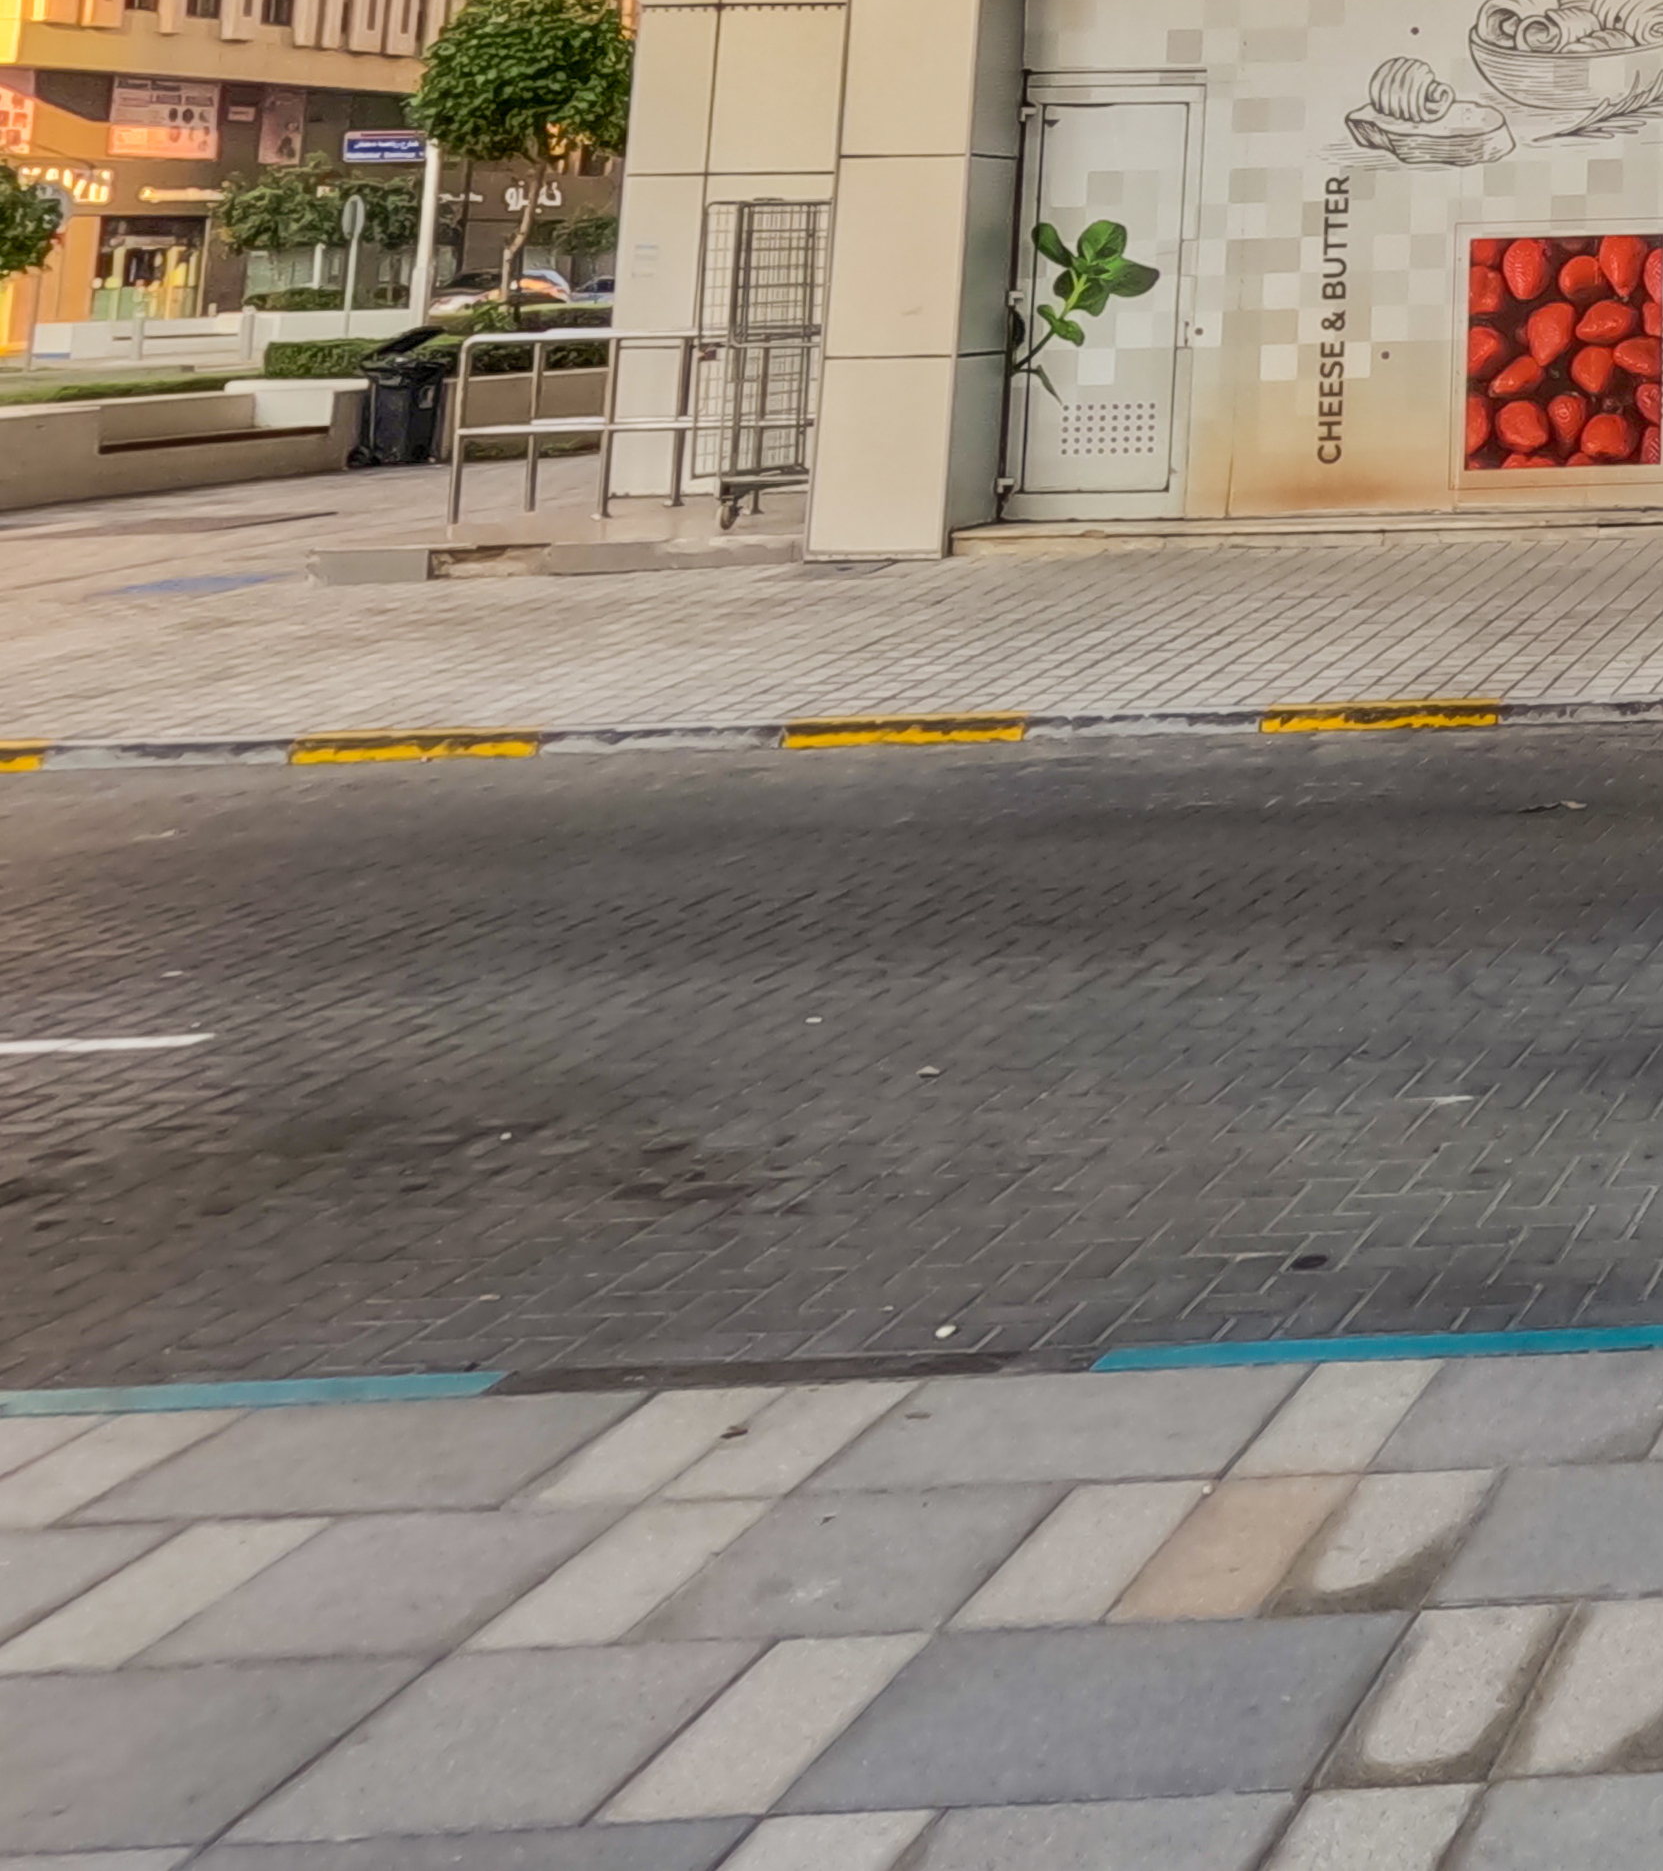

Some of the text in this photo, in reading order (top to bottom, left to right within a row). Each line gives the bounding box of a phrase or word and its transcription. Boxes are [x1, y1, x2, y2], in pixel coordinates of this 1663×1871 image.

[1317, 175, 1350, 465] CHEESE & BUTTER
